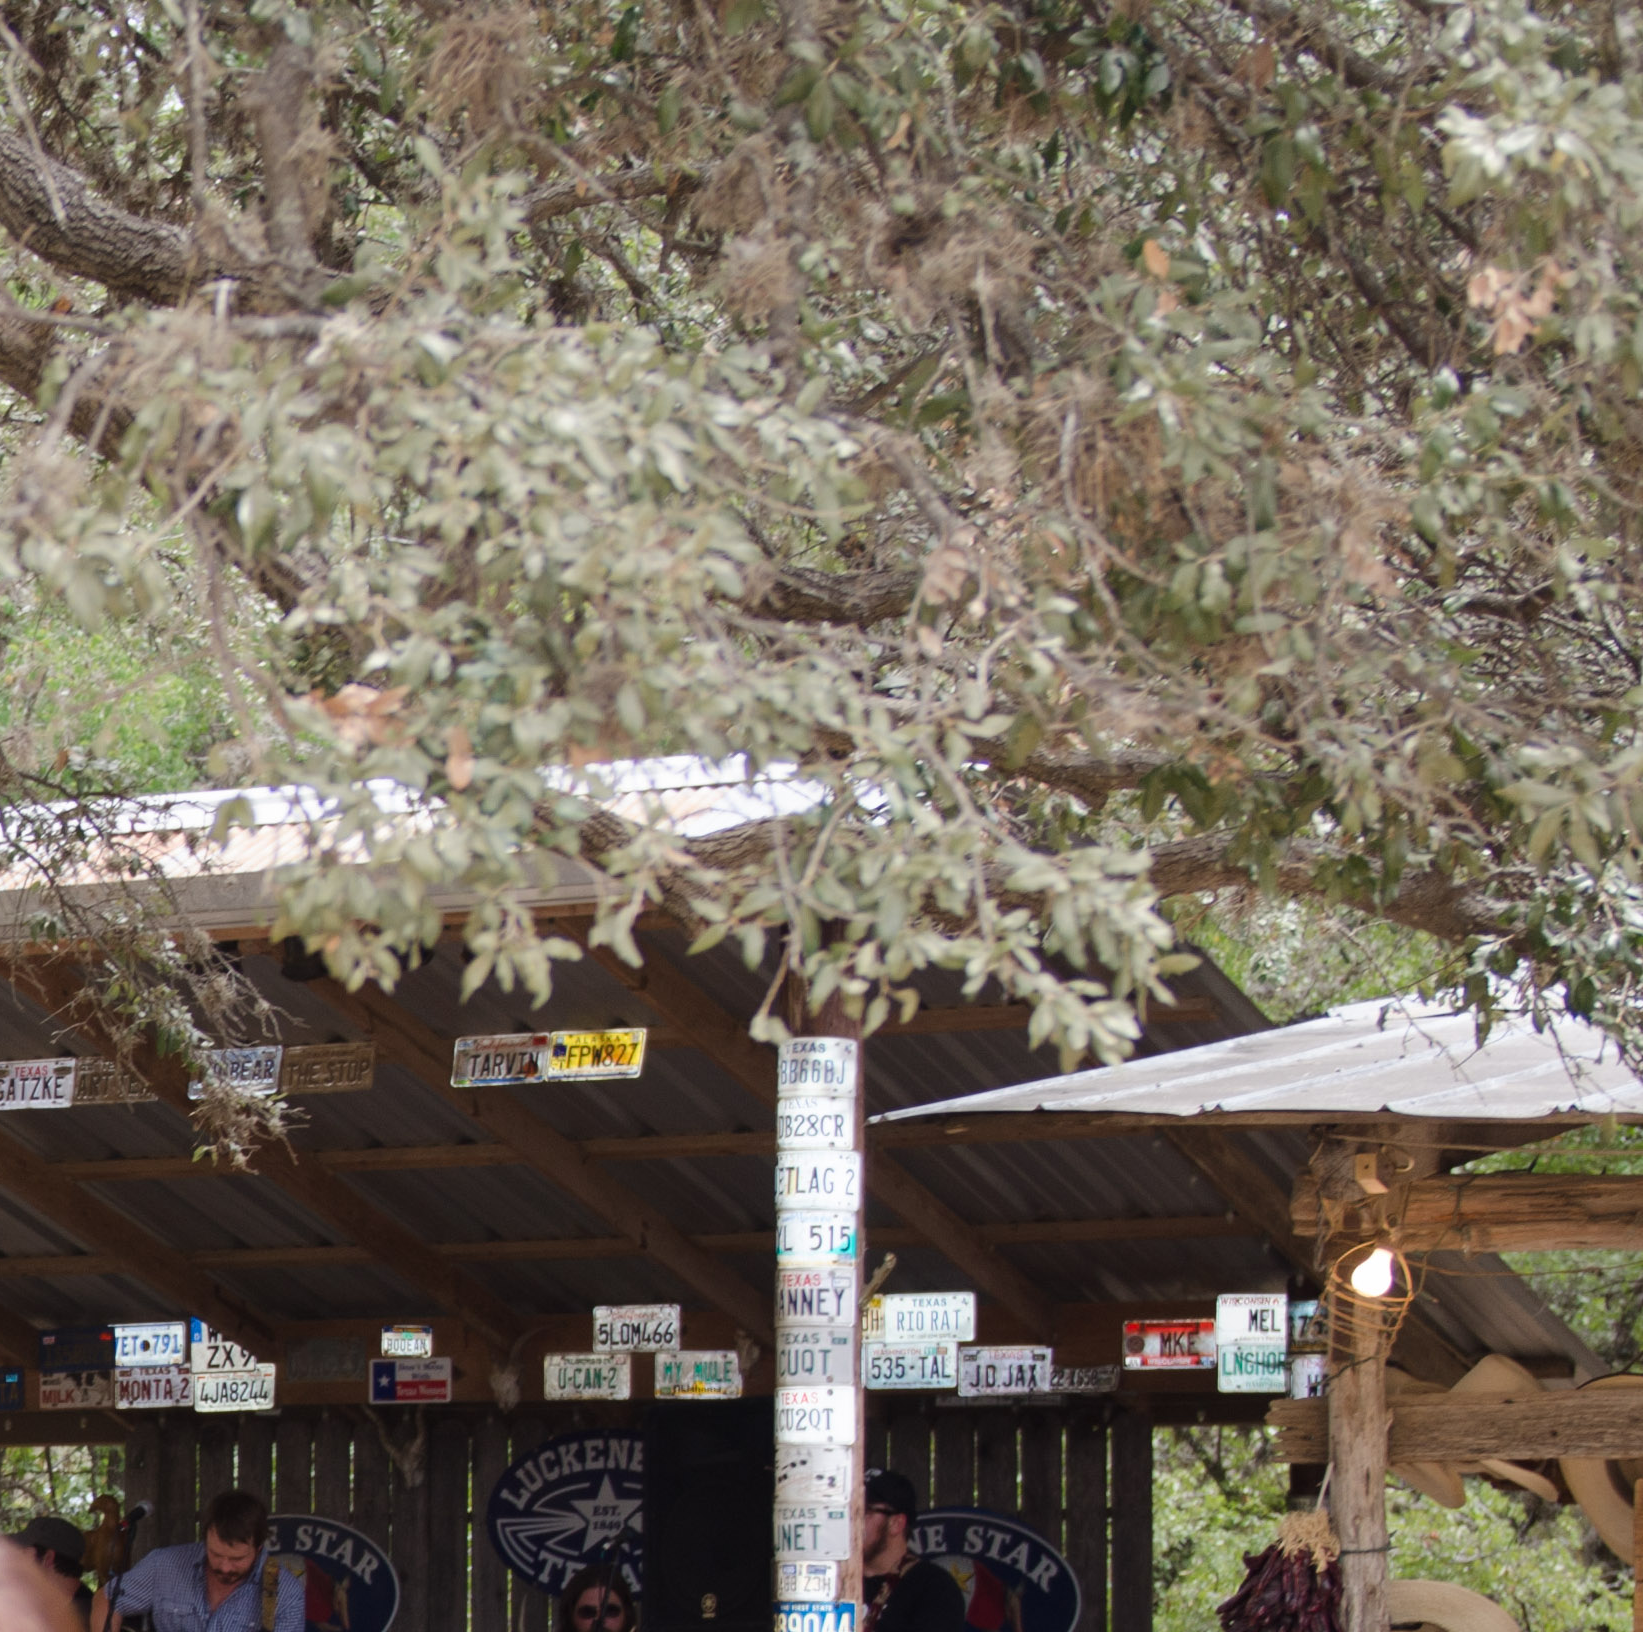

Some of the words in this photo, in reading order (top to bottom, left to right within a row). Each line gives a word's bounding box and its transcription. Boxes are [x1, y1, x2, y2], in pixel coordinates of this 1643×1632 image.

[575, 1036, 620, 1044] ALASKA
[786, 1042, 826, 1053] TEXAS
[567, 1043, 639, 1069] FPW827
[15, 1065, 49, 1077] TEXAS
[785, 1097, 817, 1109] TEXAS
[809, 1225, 851, 1252] 515
[782, 1274, 821, 1287] TEXAS
[912, 1298, 947, 1307] TEXAS
[1221, 1296, 1271, 1305] WISCONSIN
[897, 1310, 924, 1331] RIO
[930, 1309, 962, 1330] RAT
[1248, 1309, 1281, 1332] MEL
[152, 1333, 181, 1355] 791
[780, 1333, 819, 1344] TEXAS
[1159, 1331, 1200, 1357] MKE
[207, 1345, 235, 1369] ZX
[139, 1367, 171, 1376] TEXAS
[664, 1361, 683, 1383] MY
[42, 1389, 75, 1404] MILK
[119, 1380, 173, 1400] MONTA
[180, 1378, 190, 1399] 2
[200, 1381, 268, 1405] 4JA8244
[781, 1392, 818, 1405] TEXAS
[778, 1508, 817, 1519] TEXAS
[295, 1525, 379, 1586] STAR
[964, 1525, 1059, 1593] STAR
